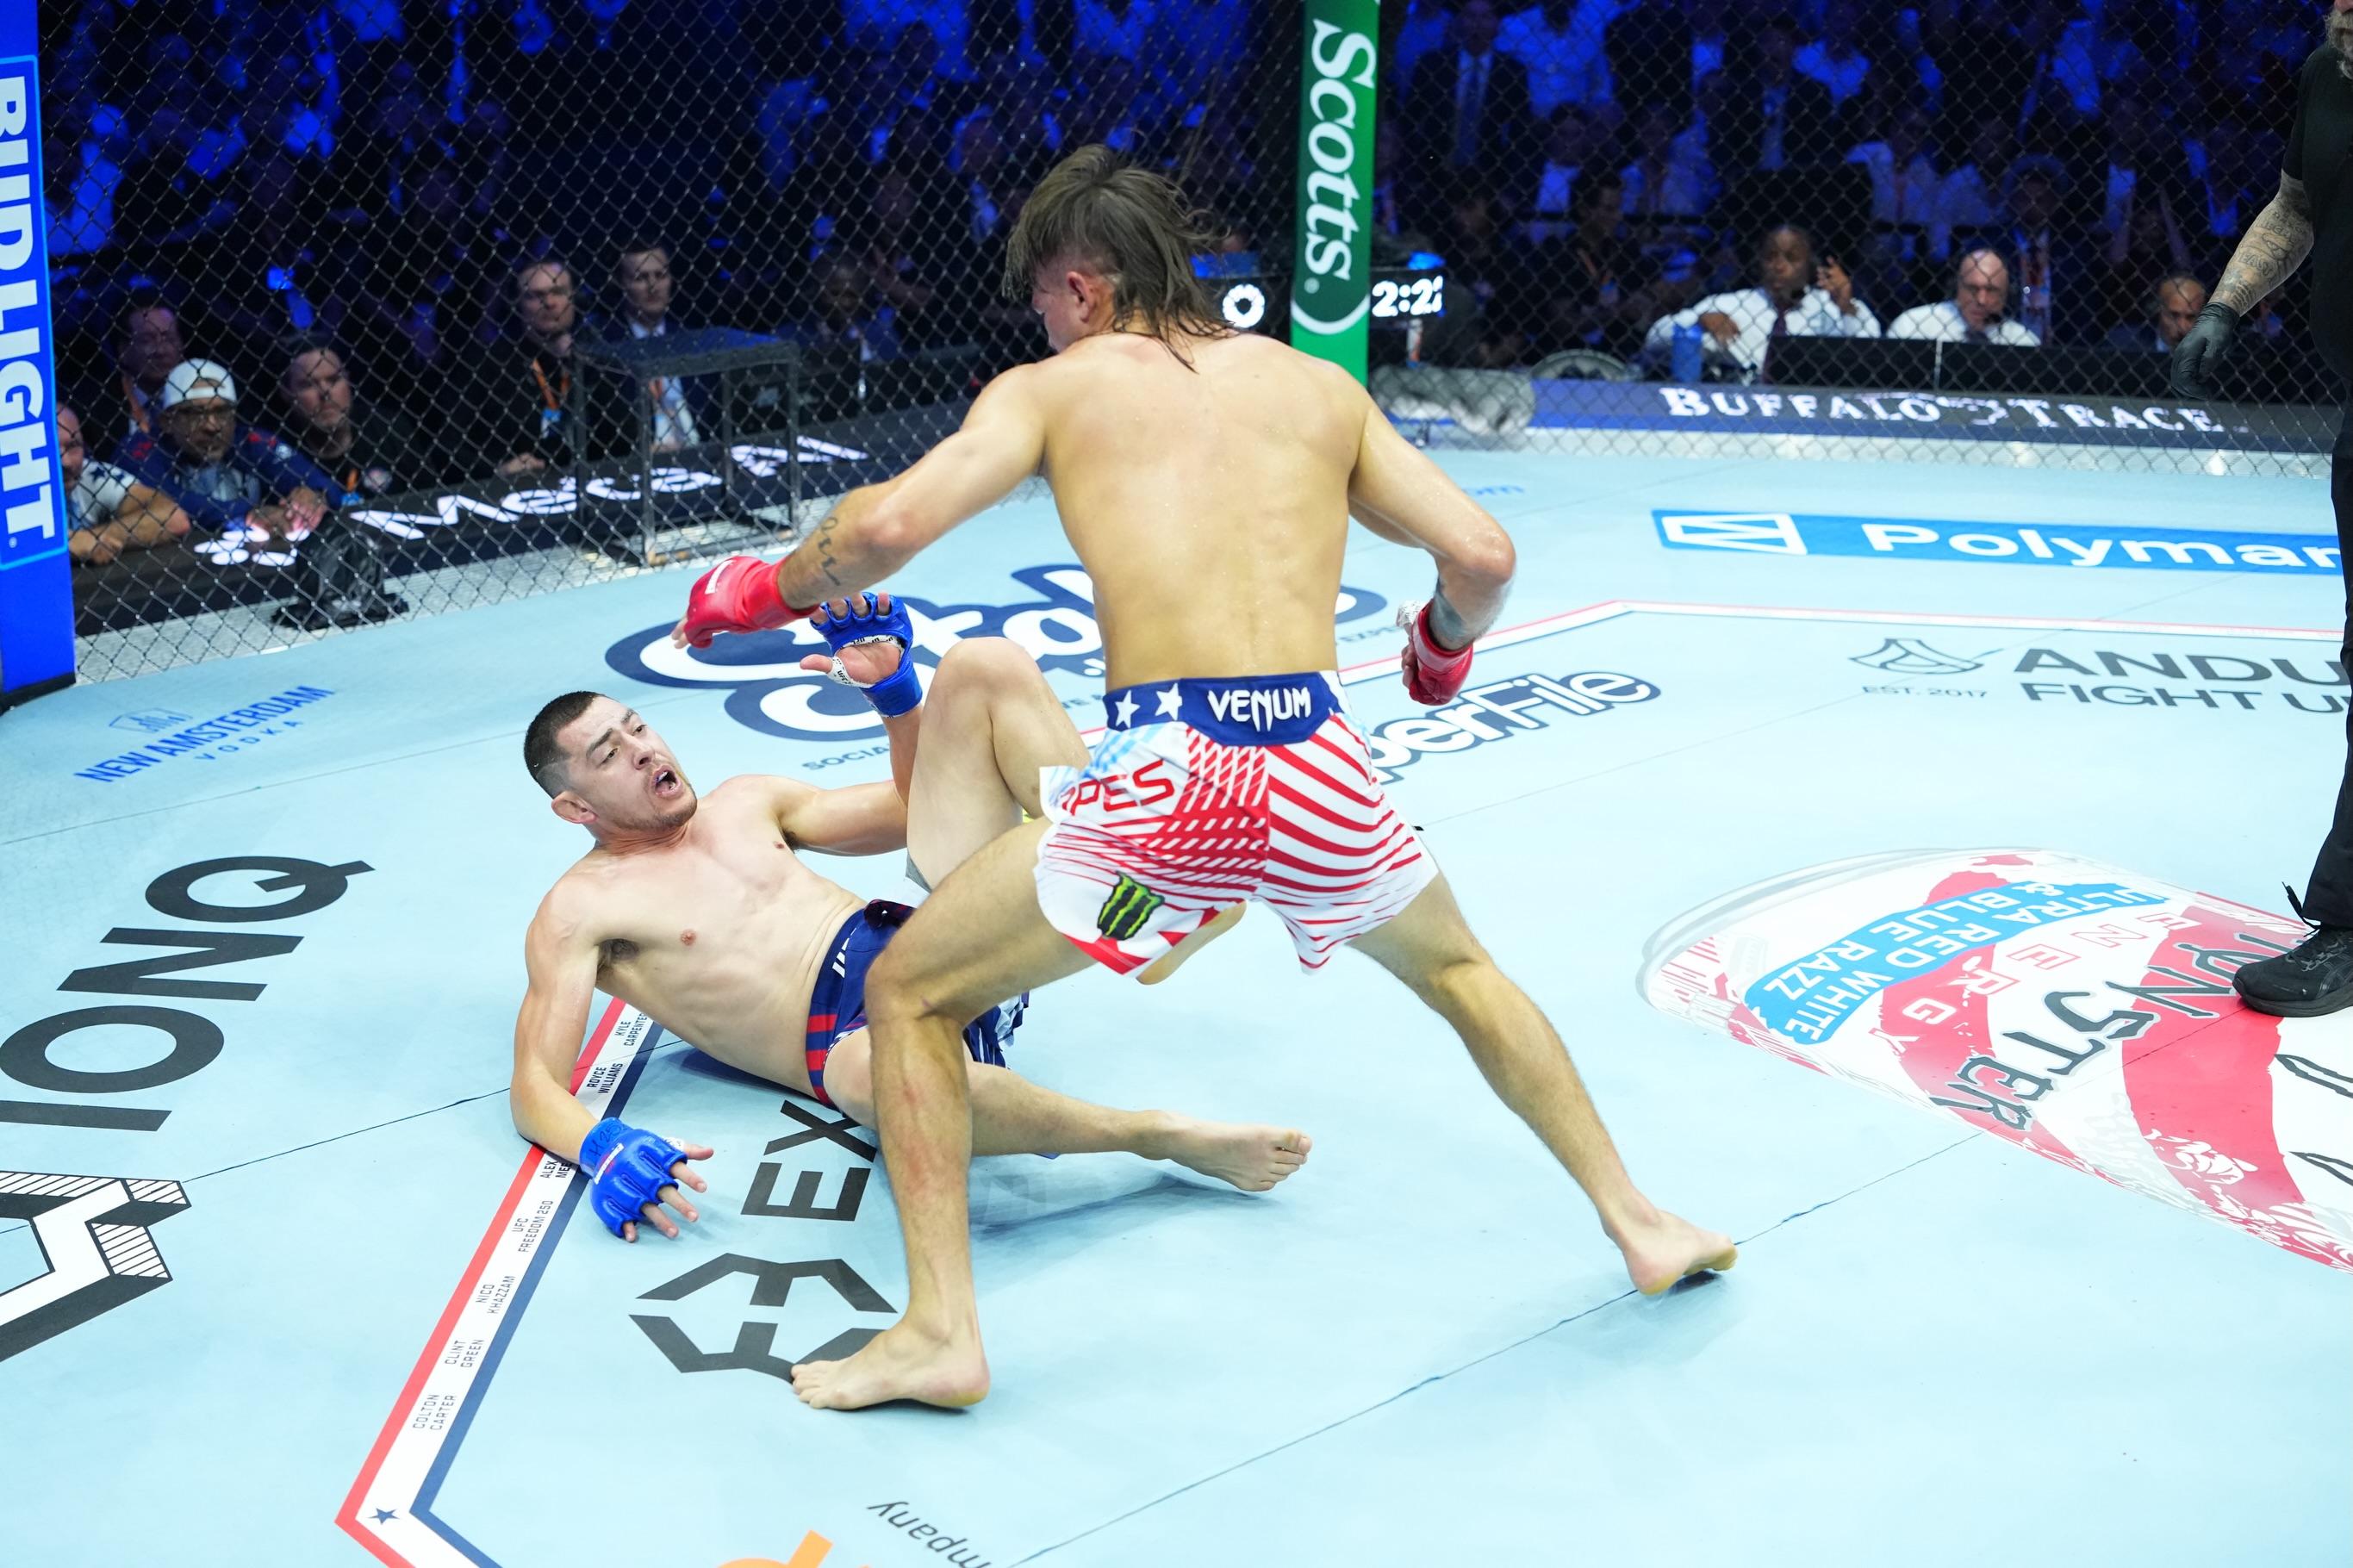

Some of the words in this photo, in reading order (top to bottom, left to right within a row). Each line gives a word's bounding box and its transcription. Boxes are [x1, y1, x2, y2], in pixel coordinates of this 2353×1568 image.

[1304, 19, 1377, 281] Scotts
[0, 279, 55, 539] LIGHT
[1659, 387, 1940, 423] BUFFALO
[2010, 398, 2225, 432] TRACE
[1860, 521, 2341, 569] Polymar
[2014, 648, 2351, 686] ANDU
[1207, 686, 1312, 732] VENUM
[2020, 682, 2263, 711] FIGHT
[2281, 693, 2351, 713] U
[74, 751, 163, 783] NEW
[144, 685, 336, 756] AMSTERDAM
[195, 720, 303, 762] VODKA
[801, 743, 892, 772] SOCIA
[1990, 883, 2164, 924] ULTRA
[2020, 881, 2065, 897] &
[1868, 891, 2016, 943] BLUE
[1884, 922, 2001, 973] RED
[1762, 939, 1870, 1001] RAZZ
[1867, 911, 2202, 1058] ENERGY
[0, 856, 376, 1132] IONQ
[1783, 969, 1880, 1041] WHITE
[614, 1020, 632, 1036] KYLE
[586, 1066, 607, 1088] ROYCE
[598, 1062, 624, 1094] WILLIAMS
[540, 1160, 558, 1179] ALEX
[512, 1216, 529, 1233] UFC
[519, 1217, 546, 1253] FREEDOM
[538, 1199, 554, 1218] 250
[476, 1282, 495, 1305] NICO
[487, 1275, 516, 1315] KHAZZAM
[445, 1339, 464, 1366] CLINT
[460, 1339, 484, 1368] GREEN
[412, 1392, 440, 1430] COLTON
[430, 1393, 458, 1431] CARTER
